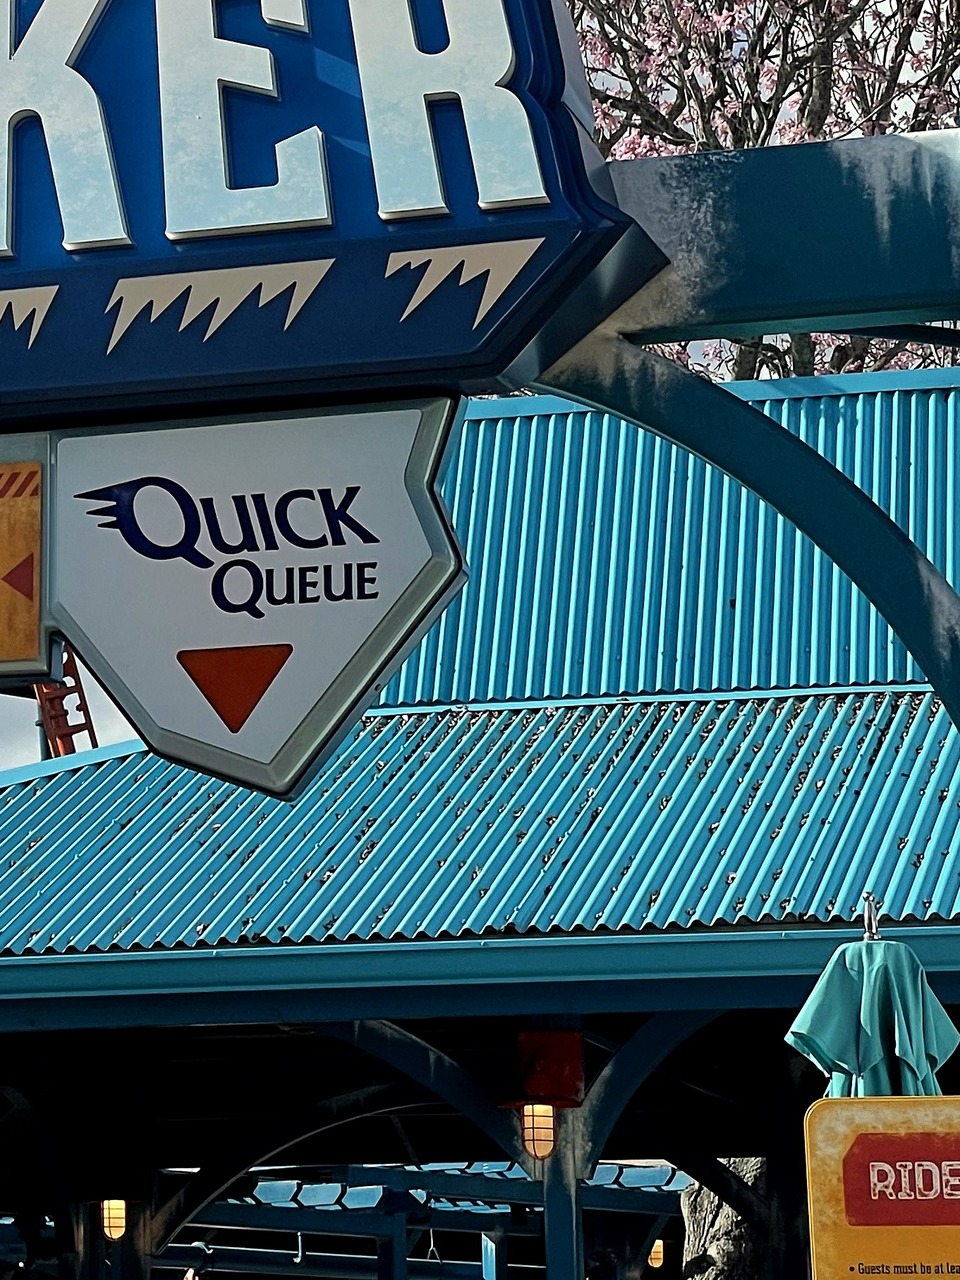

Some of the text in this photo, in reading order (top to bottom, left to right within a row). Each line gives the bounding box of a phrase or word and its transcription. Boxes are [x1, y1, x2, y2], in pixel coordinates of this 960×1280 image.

[72, 476, 381, 569] QUICK
[211, 558, 379, 619] QUEUE
[857, 1262, 891, 1275] Guests
[893, 1263, 918, 1275] must
[920, 1262, 932, 1275] be
[934, 1263, 944, 1275] at
